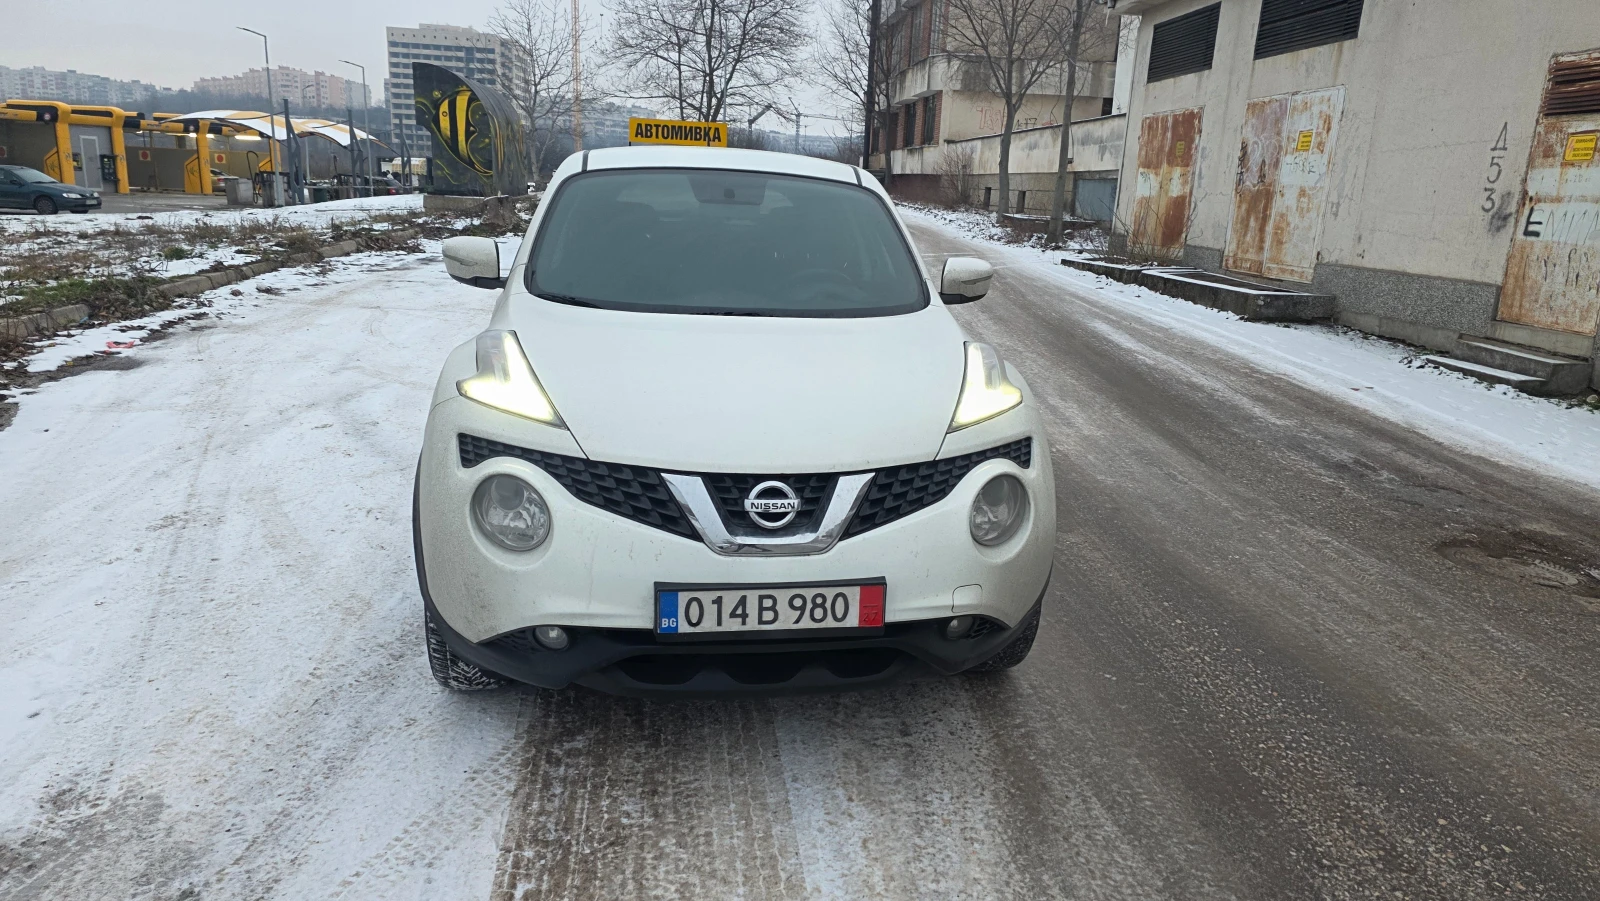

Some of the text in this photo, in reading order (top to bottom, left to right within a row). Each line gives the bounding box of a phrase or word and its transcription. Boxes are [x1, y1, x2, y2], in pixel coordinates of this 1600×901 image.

[635, 123, 721, 142] АВТОМИВКА
[751, 502, 795, 510] NISSAN
[661, 618, 677, 628] BG
[787, 591, 850, 625] 980
